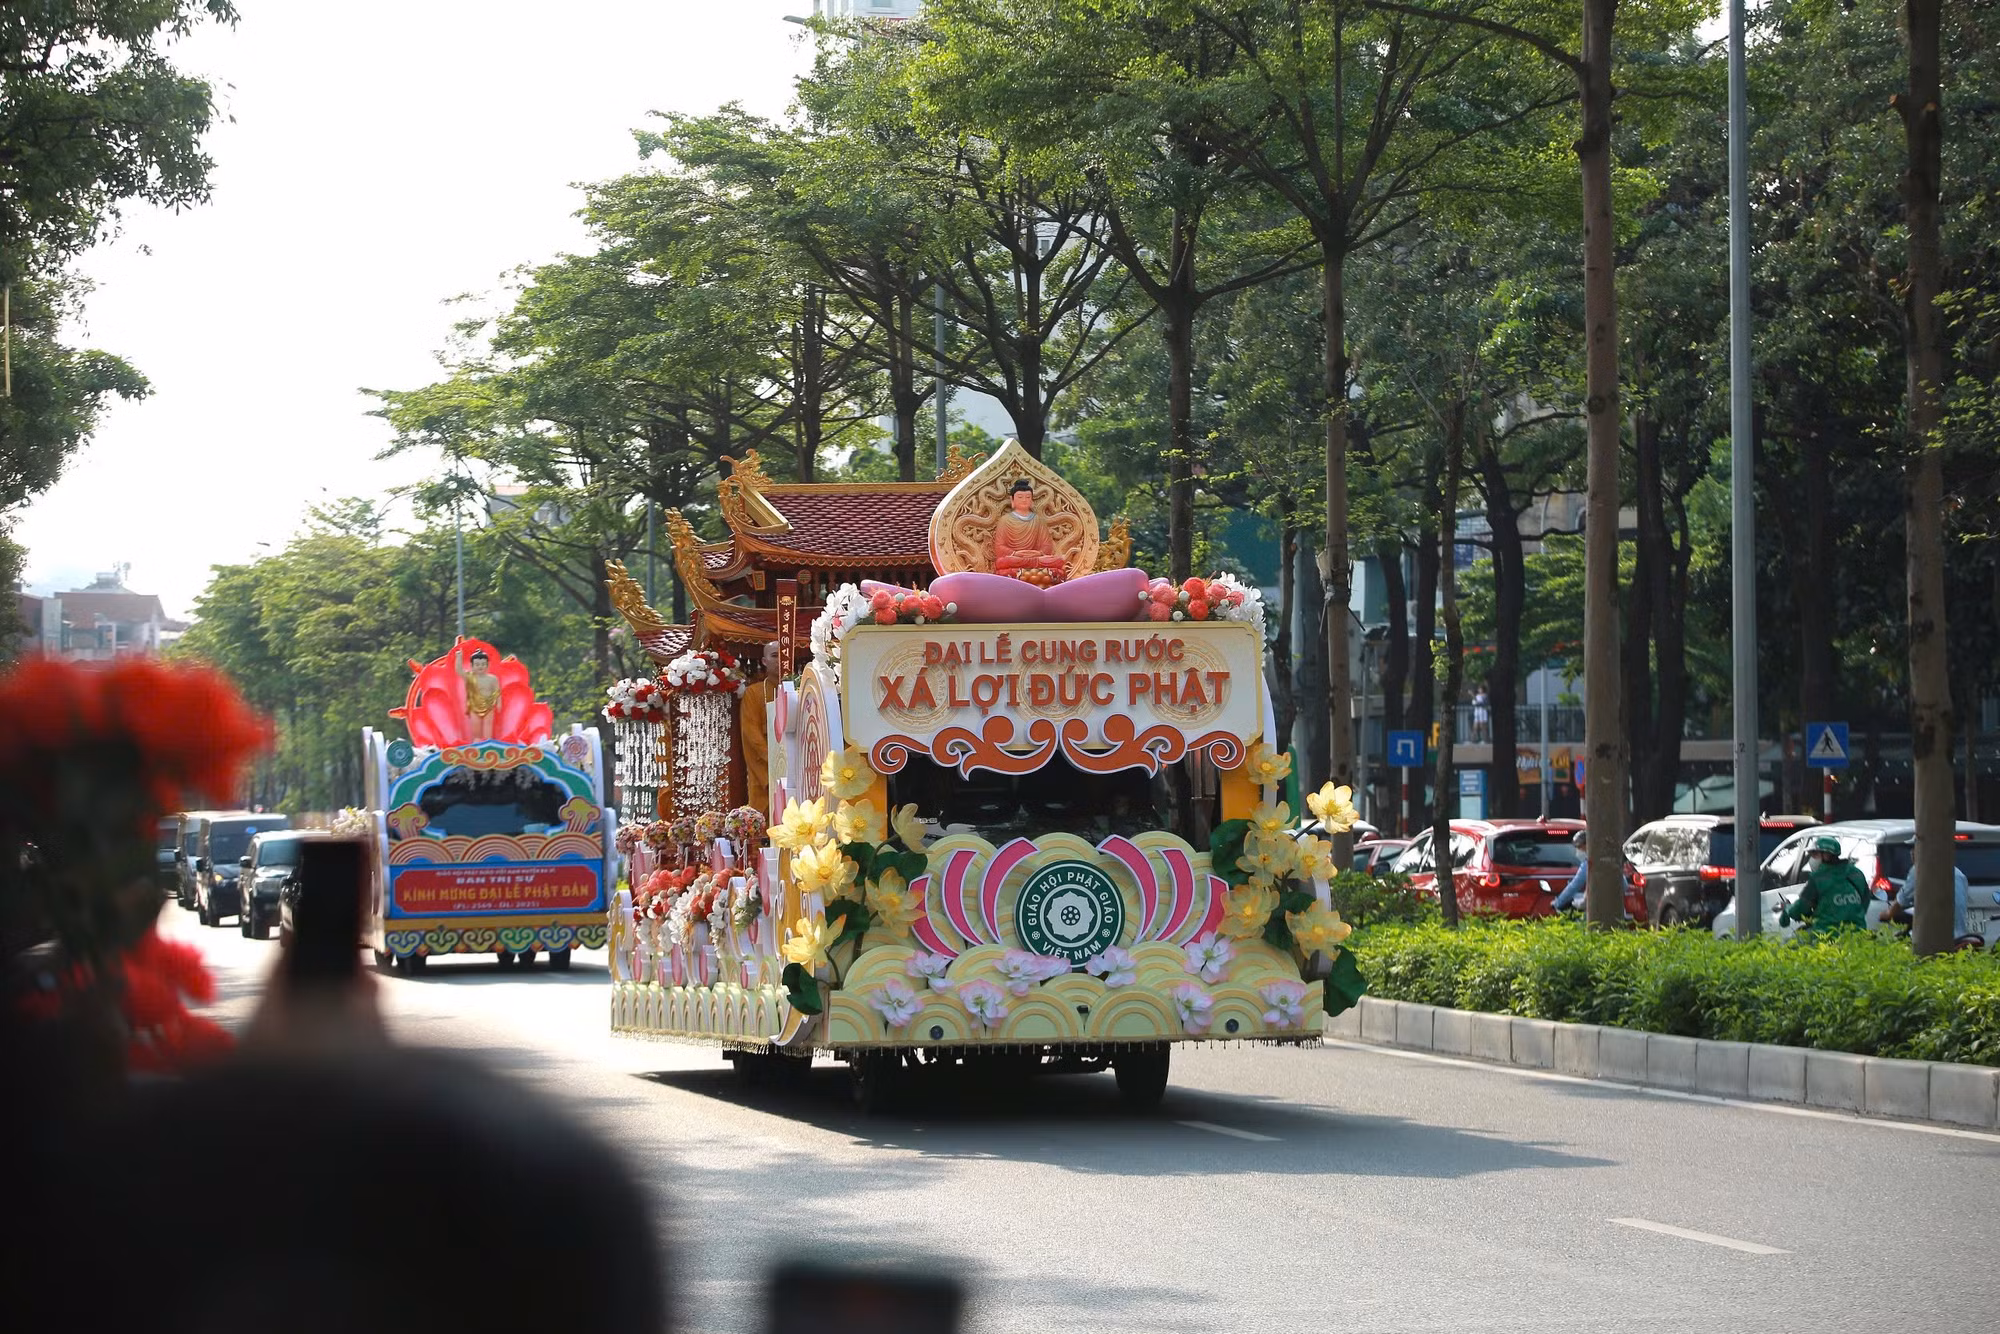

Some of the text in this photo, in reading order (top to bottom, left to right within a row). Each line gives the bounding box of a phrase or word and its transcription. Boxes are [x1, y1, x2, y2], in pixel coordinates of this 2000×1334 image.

[924, 633, 1185, 669] ĐẠI LỄ CUNG RƯỚC
[879, 666, 1230, 715] XÁ LỢI ĐỨC PHẬT
[403, 887, 436, 902] KÍNH
[1028, 871, 1115, 926] GIÁO HỘI PHẬT GIÁO
[1833, 890, 1862, 906] Grab
[1074, 940, 1101, 960] NAM
